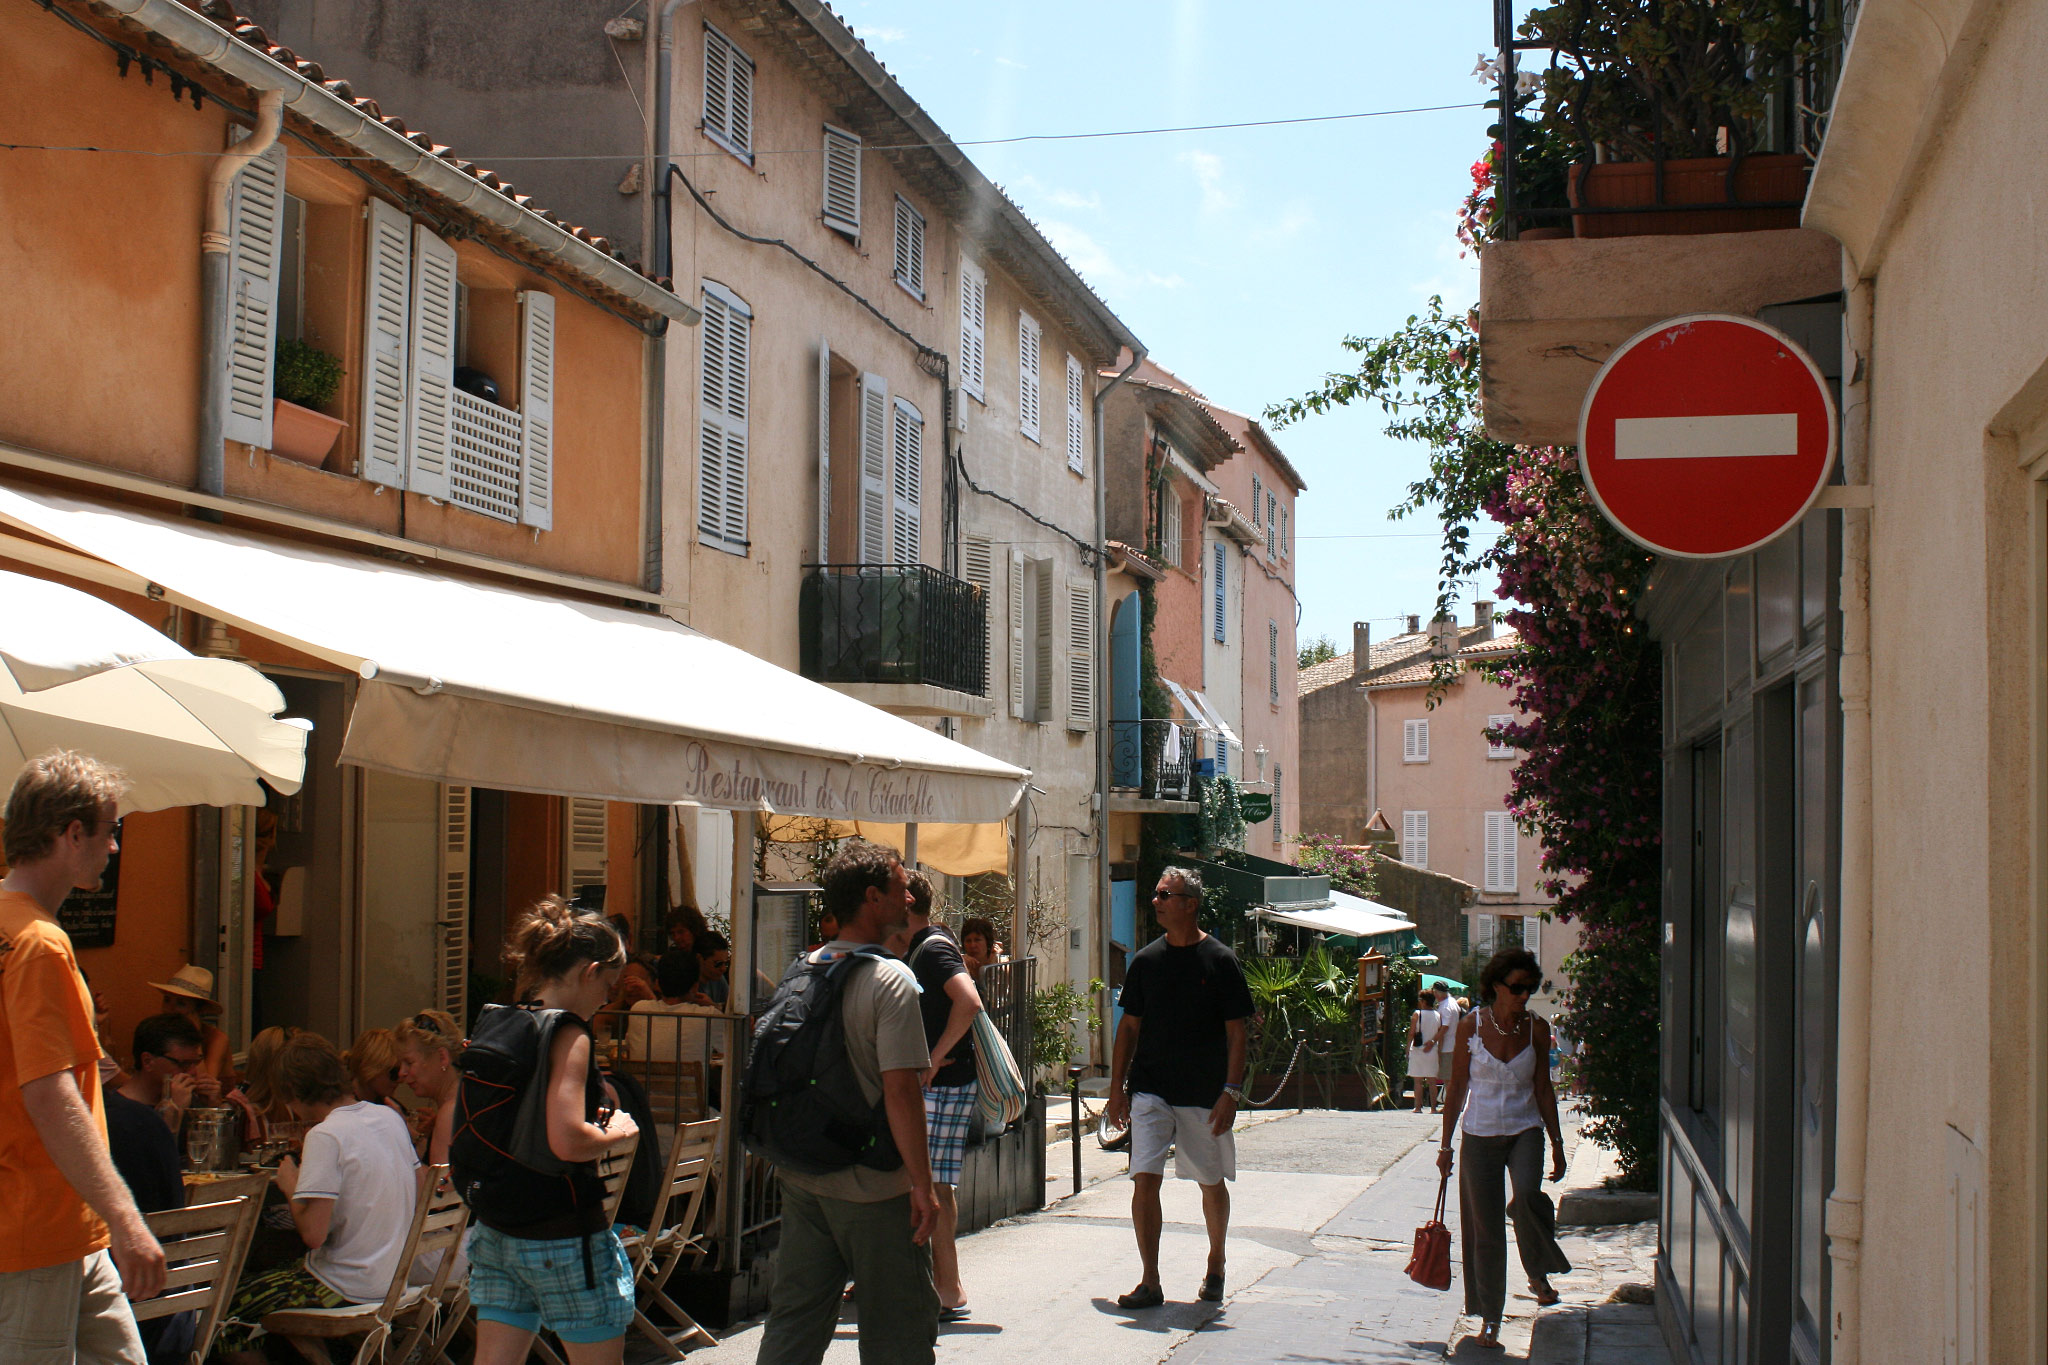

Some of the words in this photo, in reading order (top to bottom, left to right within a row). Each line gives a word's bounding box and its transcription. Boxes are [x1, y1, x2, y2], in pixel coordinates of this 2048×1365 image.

[686, 742, 807, 807] Restaurant
[816, 768, 834, 810] de
[867, 767, 934, 815] Citadelle
